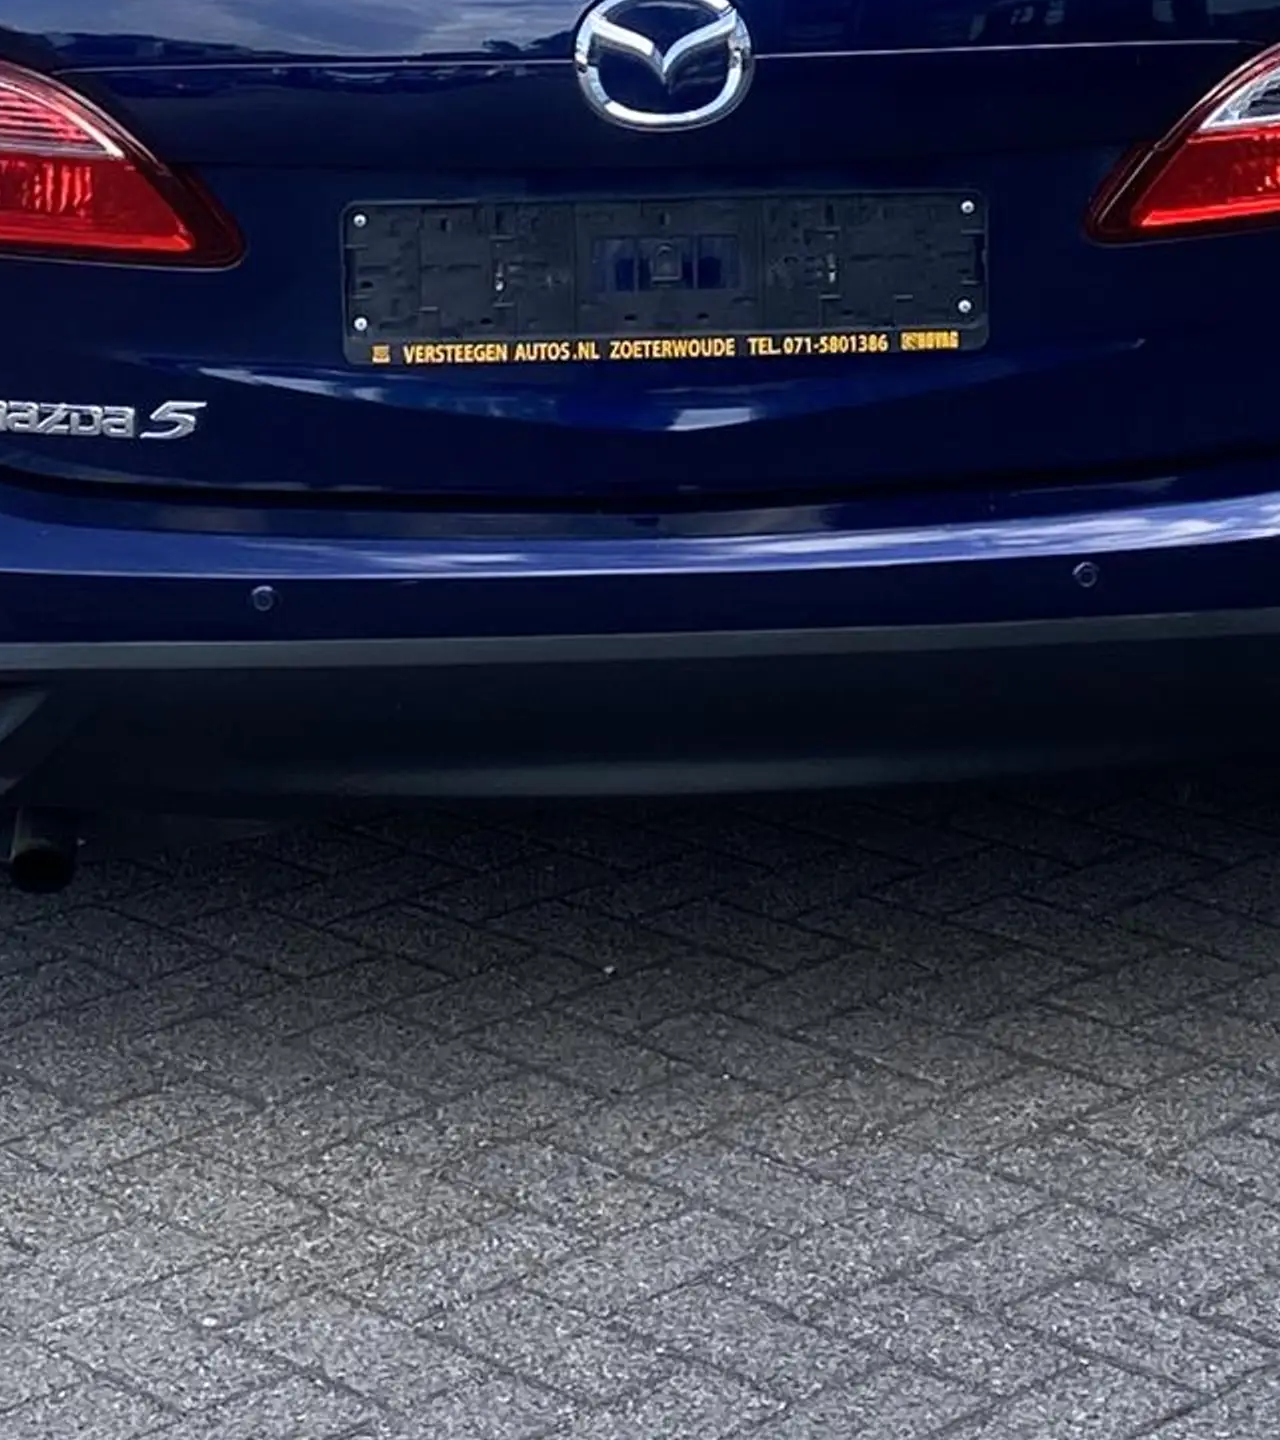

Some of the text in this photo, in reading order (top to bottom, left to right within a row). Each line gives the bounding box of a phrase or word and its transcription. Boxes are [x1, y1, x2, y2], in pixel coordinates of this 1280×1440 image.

[402, 343, 508, 364] VERSTEEGEN
[514, 341, 601, 362] AUTOS.NL
[610, 338, 736, 359] ZOETERWOUDE
